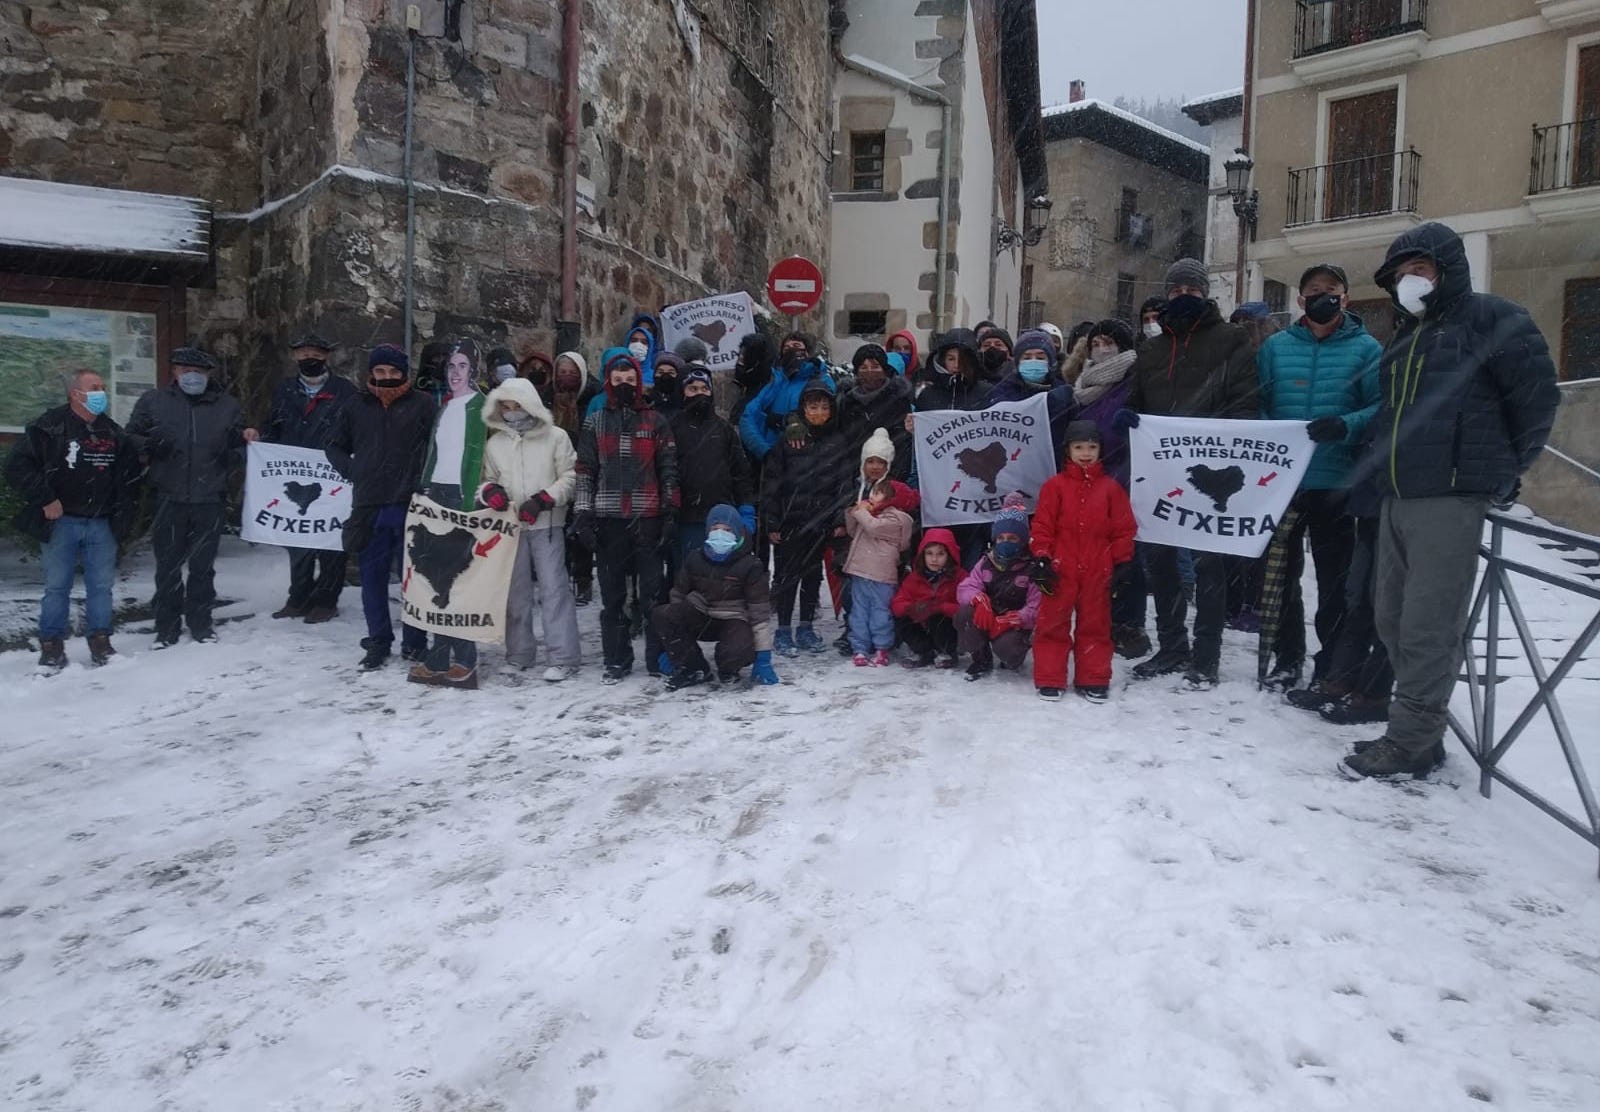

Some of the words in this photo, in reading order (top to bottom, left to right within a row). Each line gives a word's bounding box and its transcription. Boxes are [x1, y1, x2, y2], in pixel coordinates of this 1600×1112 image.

[690, 309, 744, 323] IHESLARIAK
[711, 299, 746, 313] PRESO
[925, 413, 977, 446] EUSKAL
[980, 410, 1035, 427] PRESO
[932, 440, 955, 460] ETA
[955, 426, 1033, 445] IHESLARIAK
[1159, 436, 1225, 449] EUSKAL
[1232, 437, 1289, 455] PRESO
[266, 460, 312, 469] EUSKAL
[316, 462, 337, 473] PRE
[1152, 449, 1183, 460] ETA
[1189, 448, 1295, 469] IHESLARIAK
[261, 469, 283, 478] ETA
[255, 509, 343, 534] ETXERA
[441, 510, 519, 537] PRESOAK
[1152, 498, 1277, 537] ETXERA
[426, 611, 494, 627] HERRIRA
